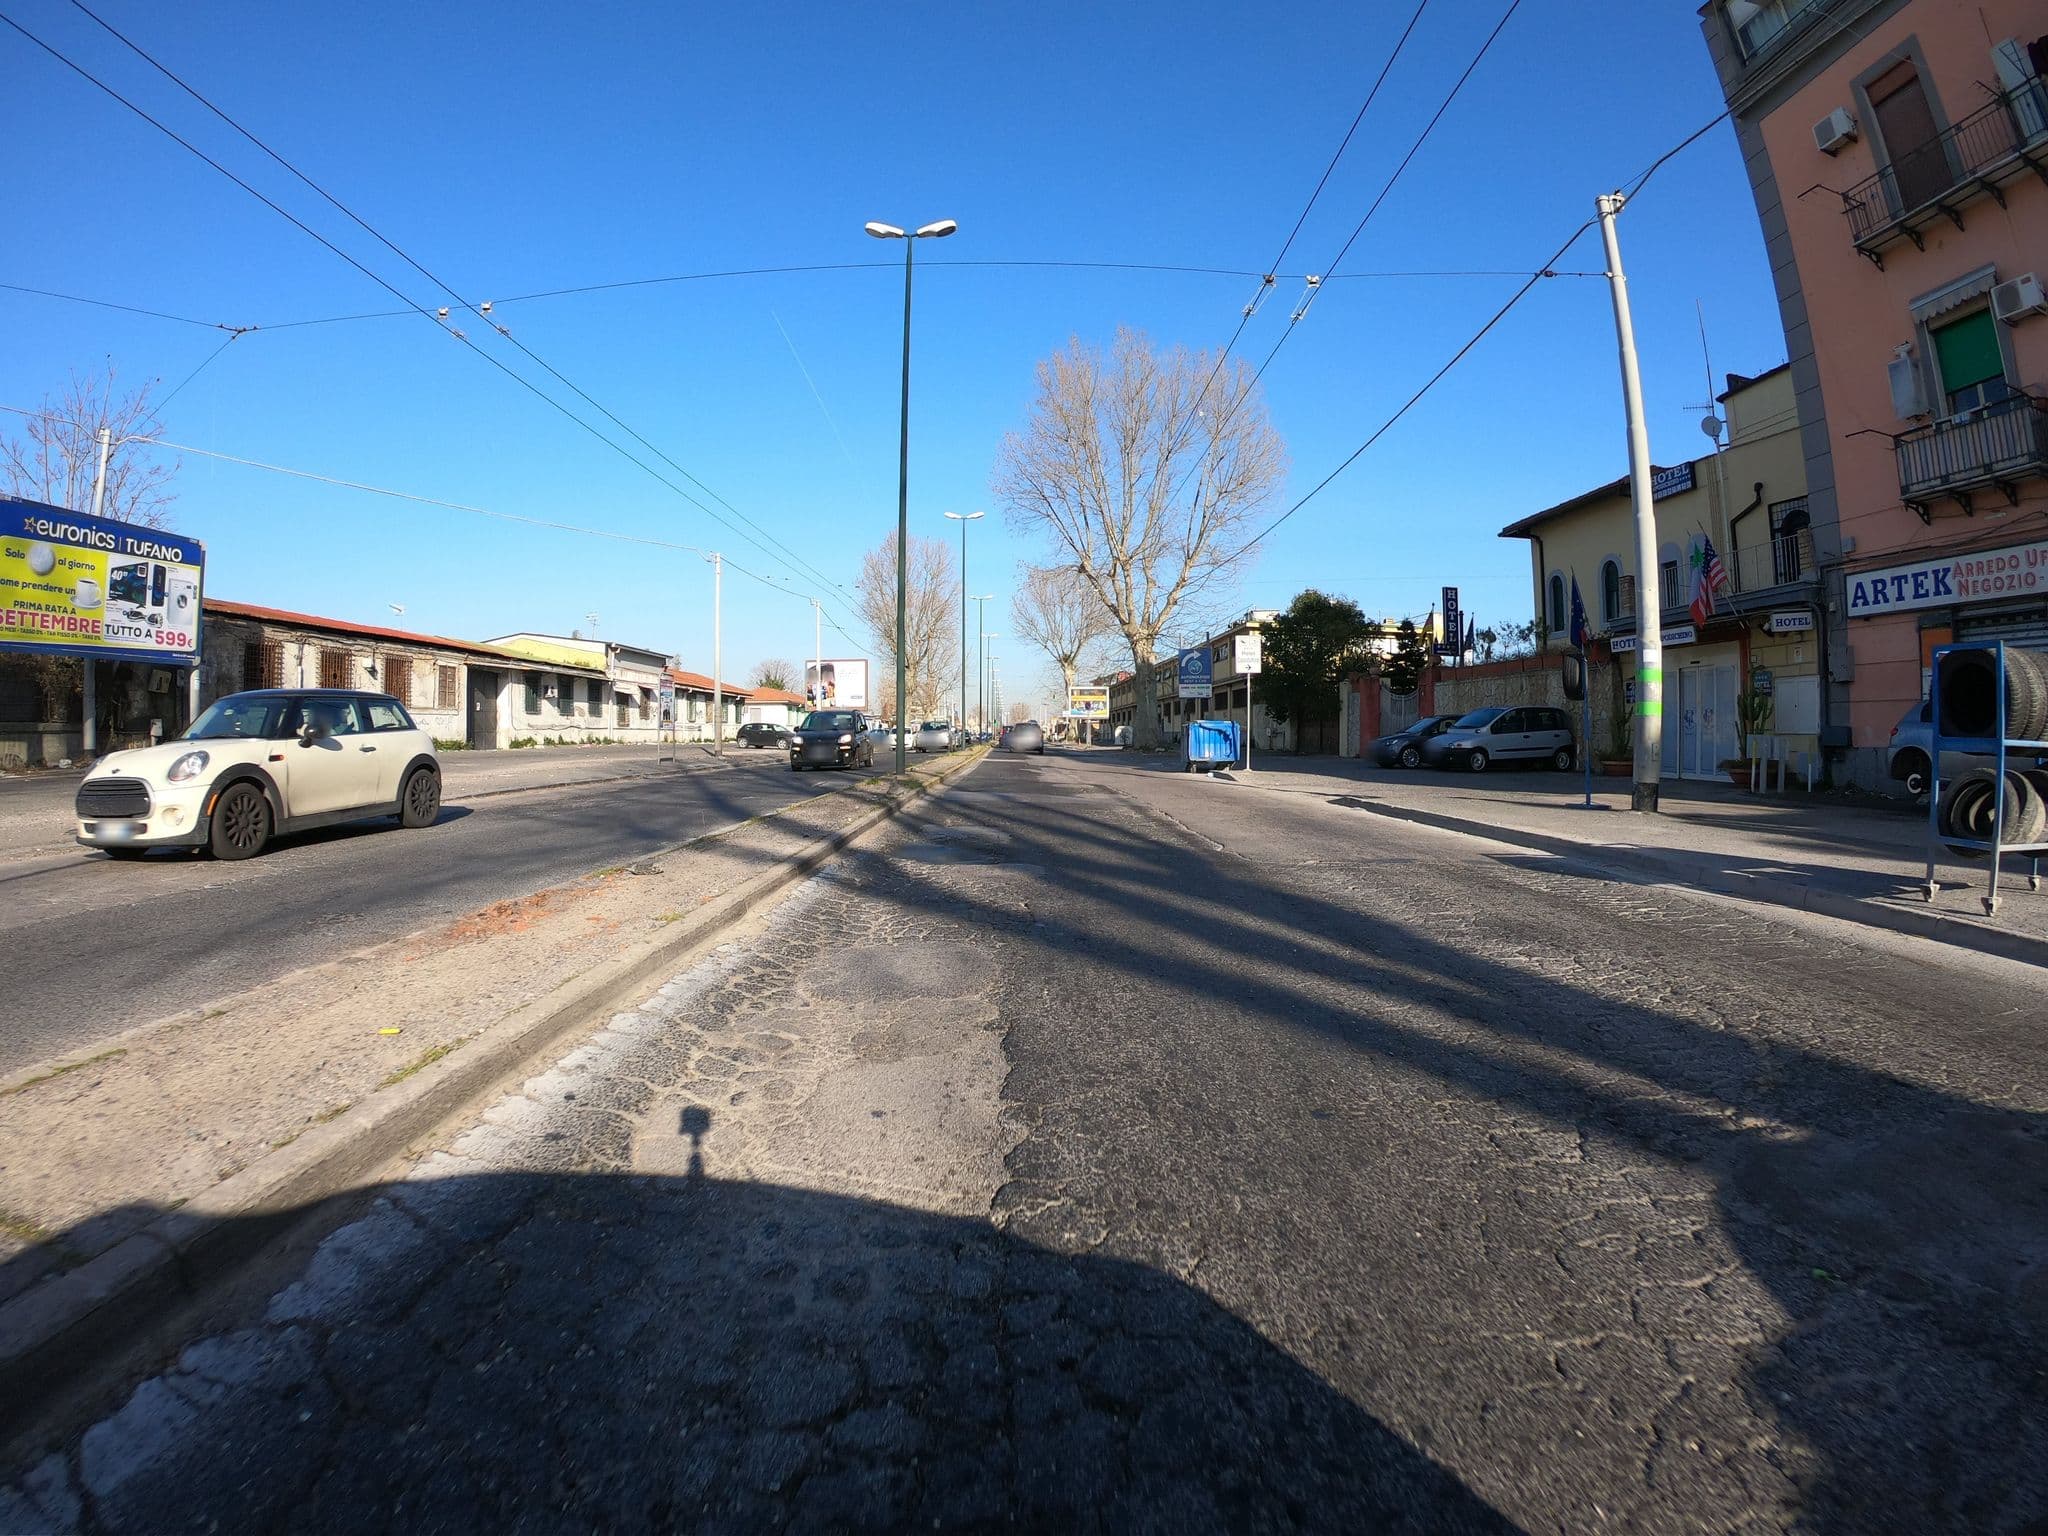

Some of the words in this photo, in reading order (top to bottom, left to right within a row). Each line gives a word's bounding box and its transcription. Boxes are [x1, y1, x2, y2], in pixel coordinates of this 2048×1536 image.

[36, 519, 115, 549] euronics
[126, 538, 182, 562] TUFANO
[5, 547, 26, 559] Solo
[57, 558, 67, 566] al
[68, 560, 96, 571] giorno
[1952, 555, 2020, 580] ARREDO
[2024, 548, 2048, 569] UF
[0, 578, 20, 587] ome
[21, 581, 64, 593] prendere
[1851, 567, 1952, 608] ARTEK
[1958, 571, 2036, 597] NEGOZIO
[13, 600, 43, 611] PRIMA
[45, 604, 69, 614] RATA
[70, 607, 77, 615] A
[1447, 590, 1457, 642] HOTEL
[1775, 616, 1811, 627] HOTEL
[105, 623, 142, 637] TUTTO
[145, 629, 153, 639] A
